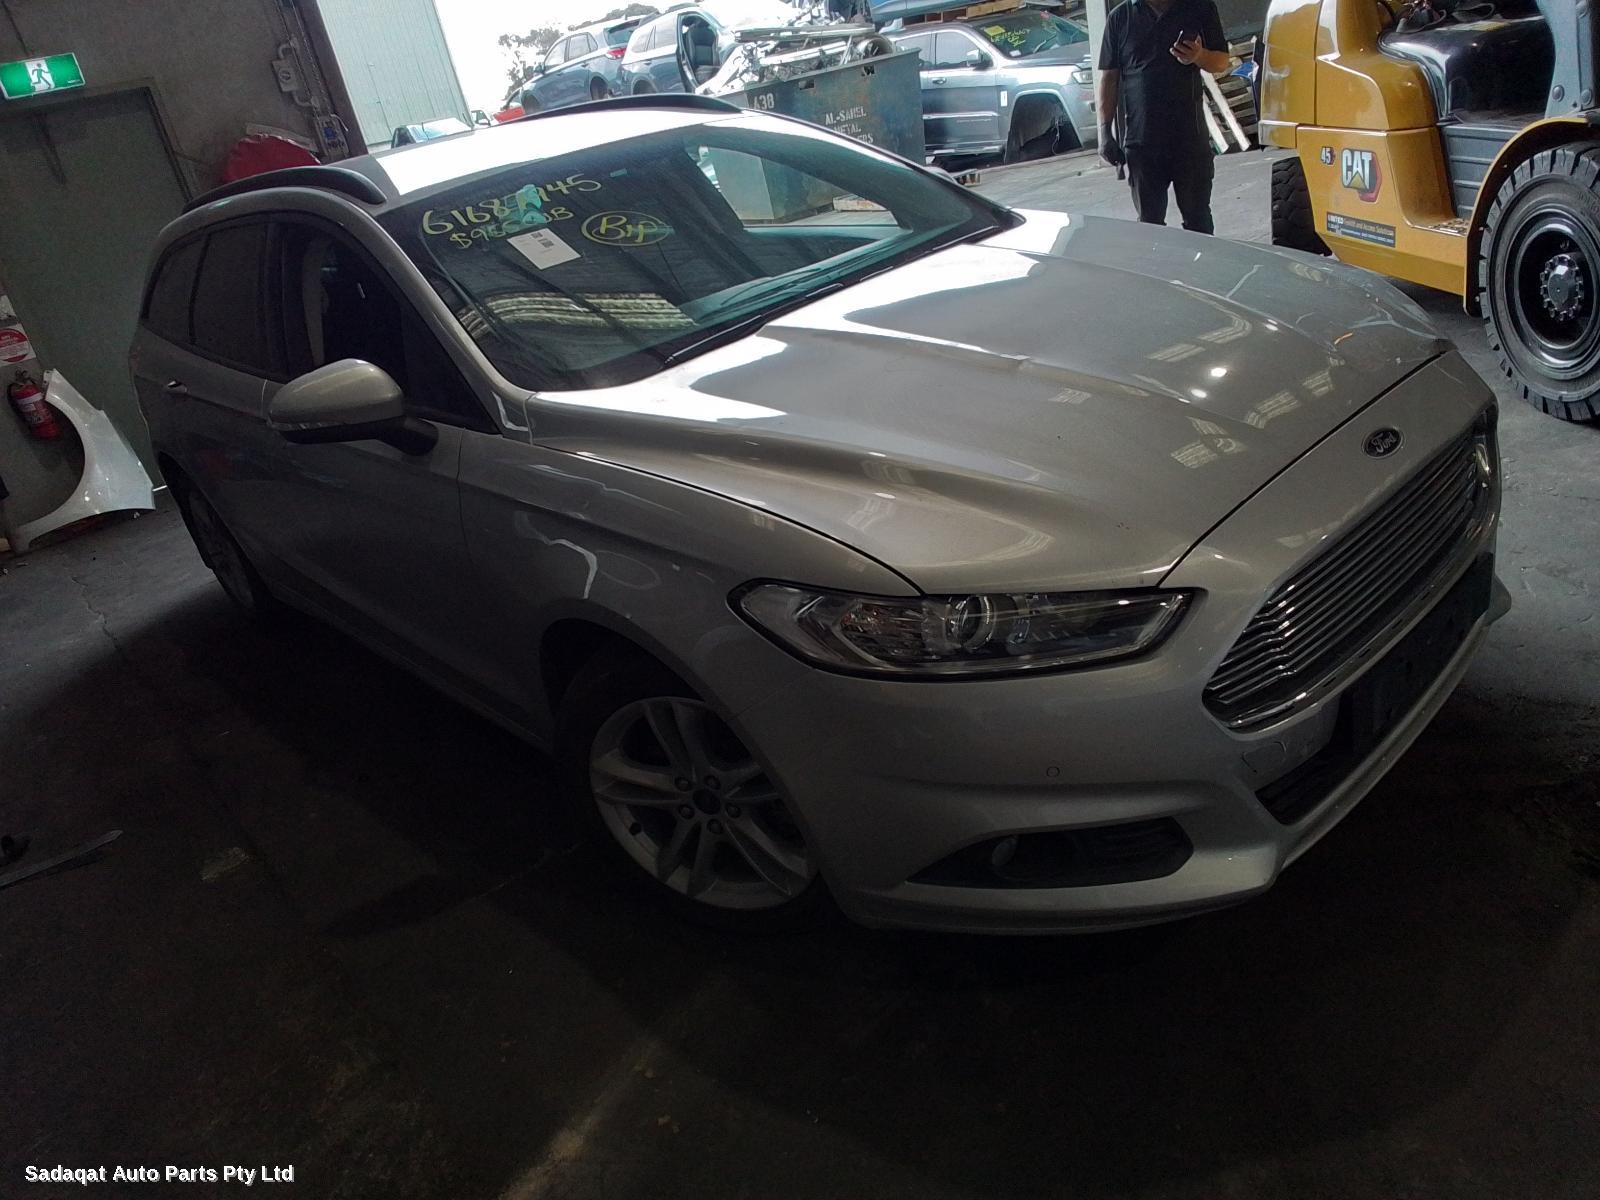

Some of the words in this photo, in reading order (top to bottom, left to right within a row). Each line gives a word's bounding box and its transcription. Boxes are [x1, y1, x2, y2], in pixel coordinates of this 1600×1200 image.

[1321, 147, 1332, 165] 45
[1342, 149, 1373, 190] CAT
[1371, 430, 1398, 453] Ford
